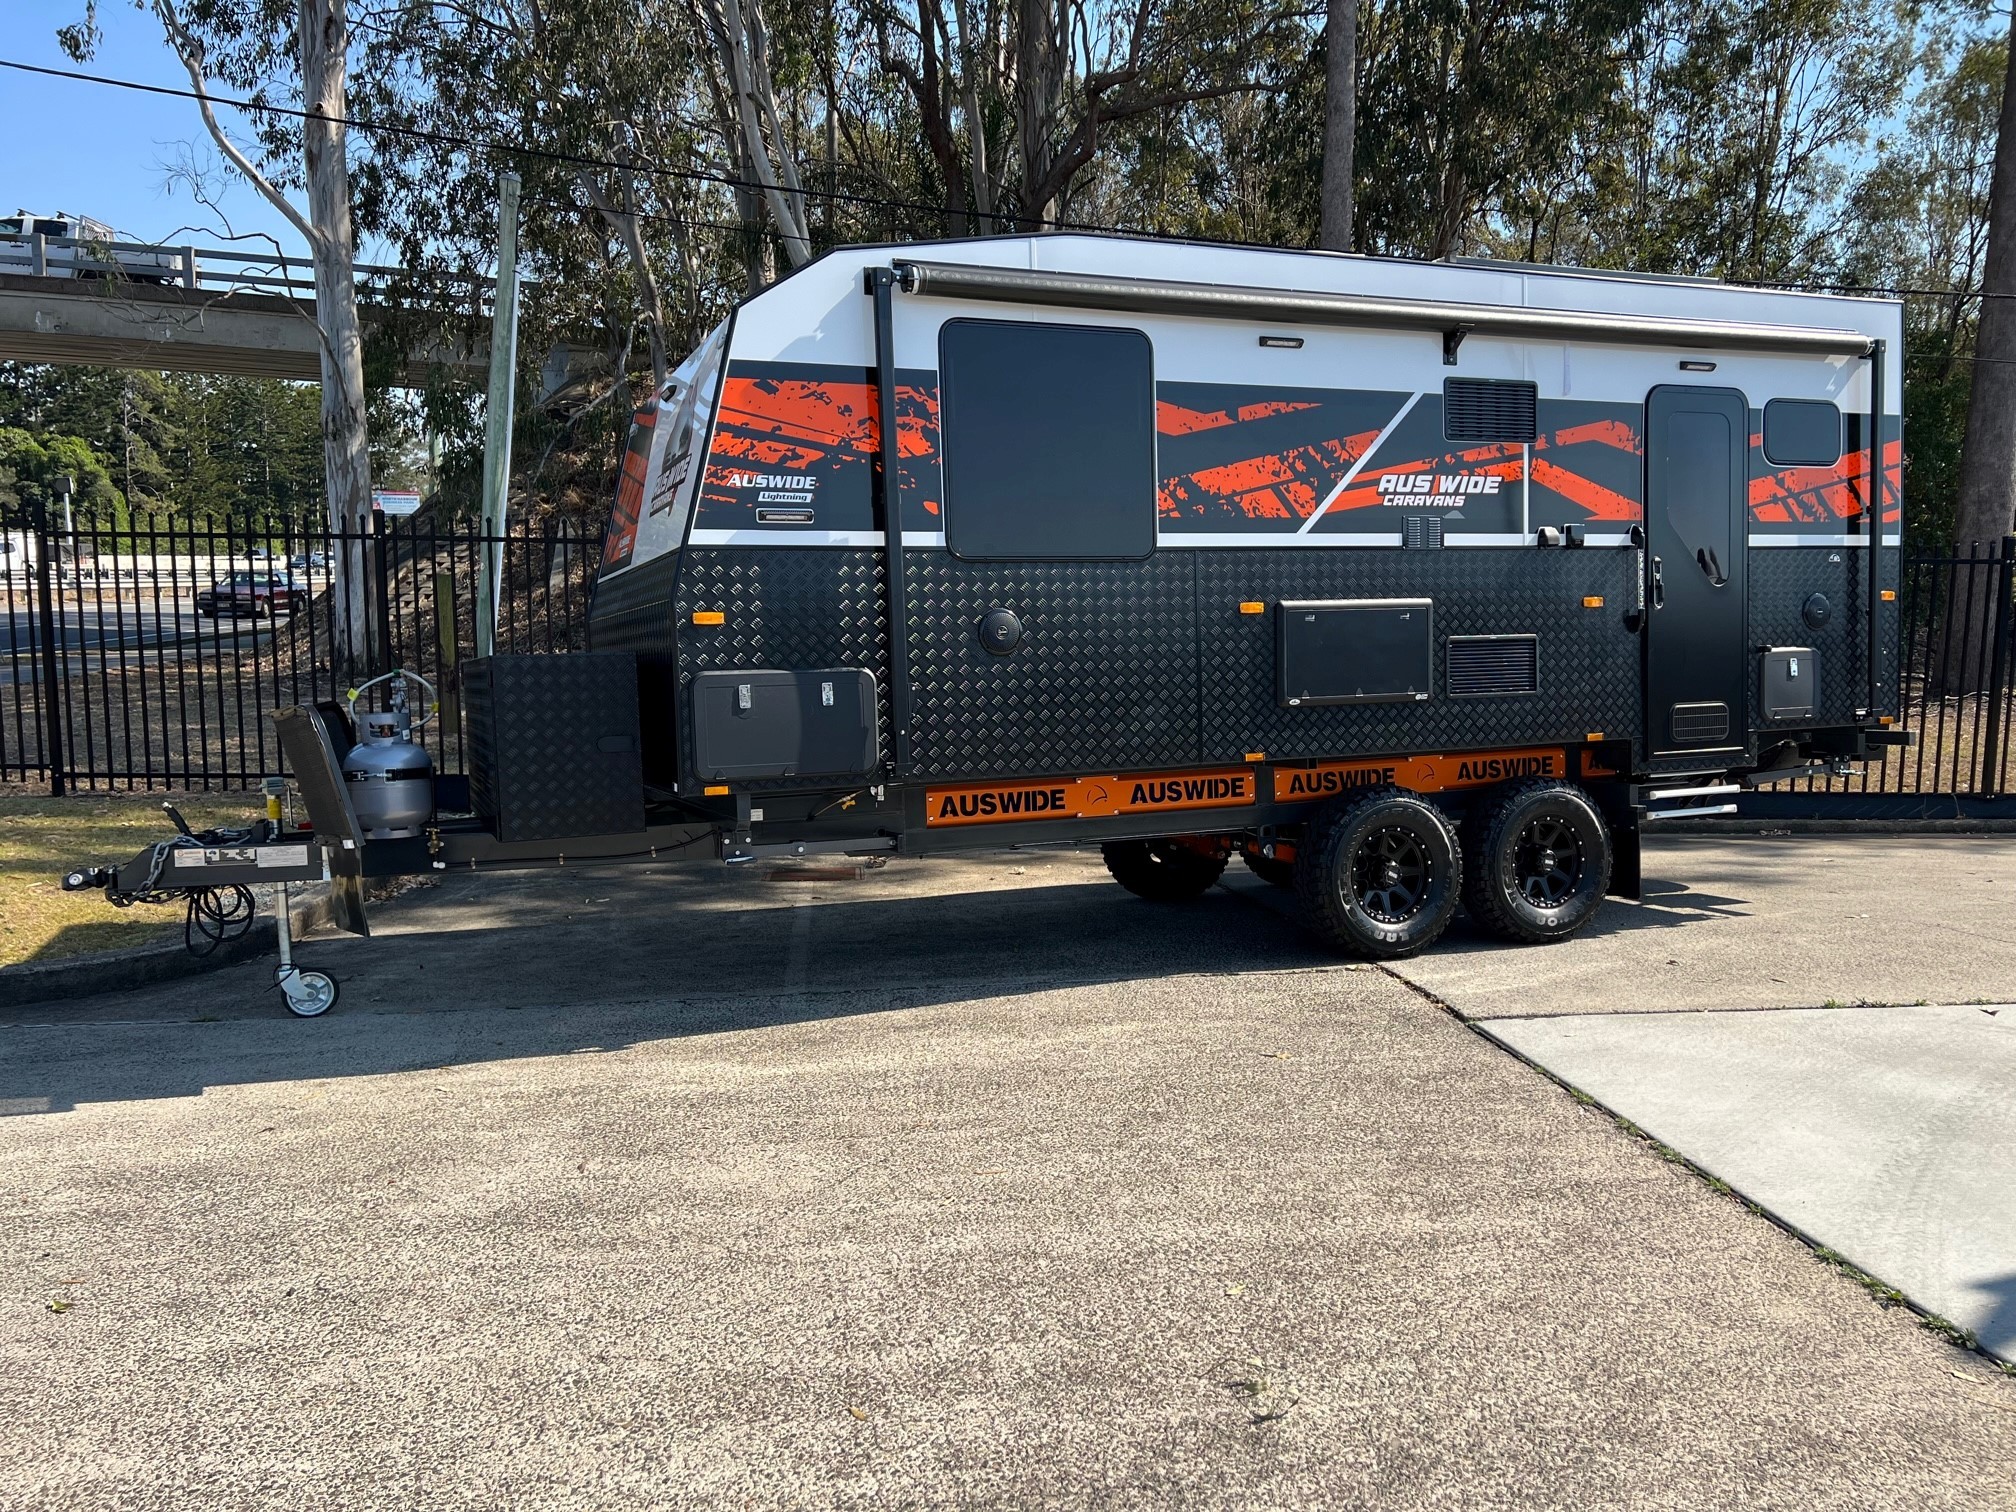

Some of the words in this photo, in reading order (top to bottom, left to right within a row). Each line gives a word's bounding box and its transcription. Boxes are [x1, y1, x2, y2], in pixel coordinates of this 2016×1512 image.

[726, 473, 817, 489] AUSWIDE
[1378, 474, 1433, 493] AUS
[1439, 475, 1503, 494] WIDE
[761, 492, 808, 502] Lightning
[1383, 494, 1466, 507] CARAVANS
[1456, 755, 1554, 780] AUSWIDE
[1129, 777, 1246, 805] AUSWIDE
[1288, 767, 1396, 794] AUSWIDE
[938, 788, 1066, 818] AUSWIDE
